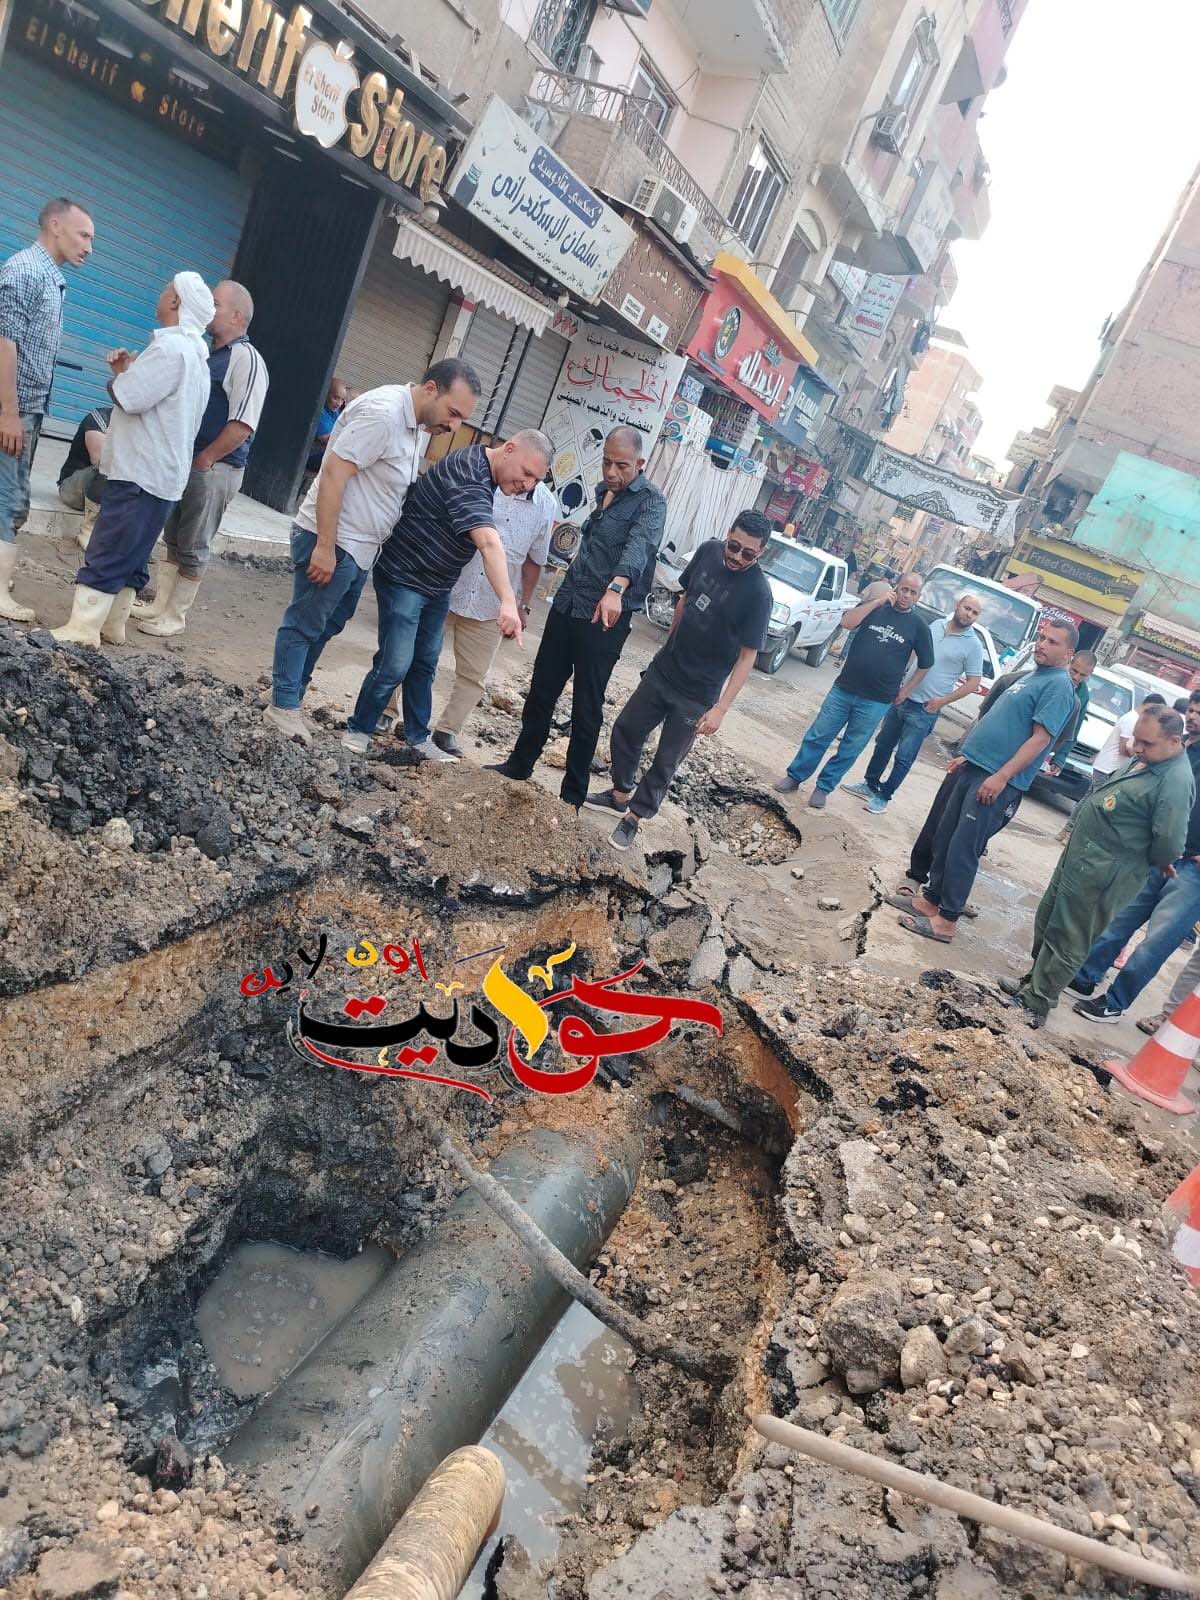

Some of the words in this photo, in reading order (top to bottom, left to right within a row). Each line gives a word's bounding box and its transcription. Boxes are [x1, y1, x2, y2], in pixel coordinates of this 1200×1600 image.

[25, 15, 48, 47] El
[54, 32, 119, 86] Sherif
[159, 94, 205, 136] Store
[311, 94, 336, 123] Store
[350, 71, 448, 201] Store
[559, 231, 599, 268] سلمان
[1030, 551, 1059, 570] Fried
[1060, 563, 1105, 587] Chicken
